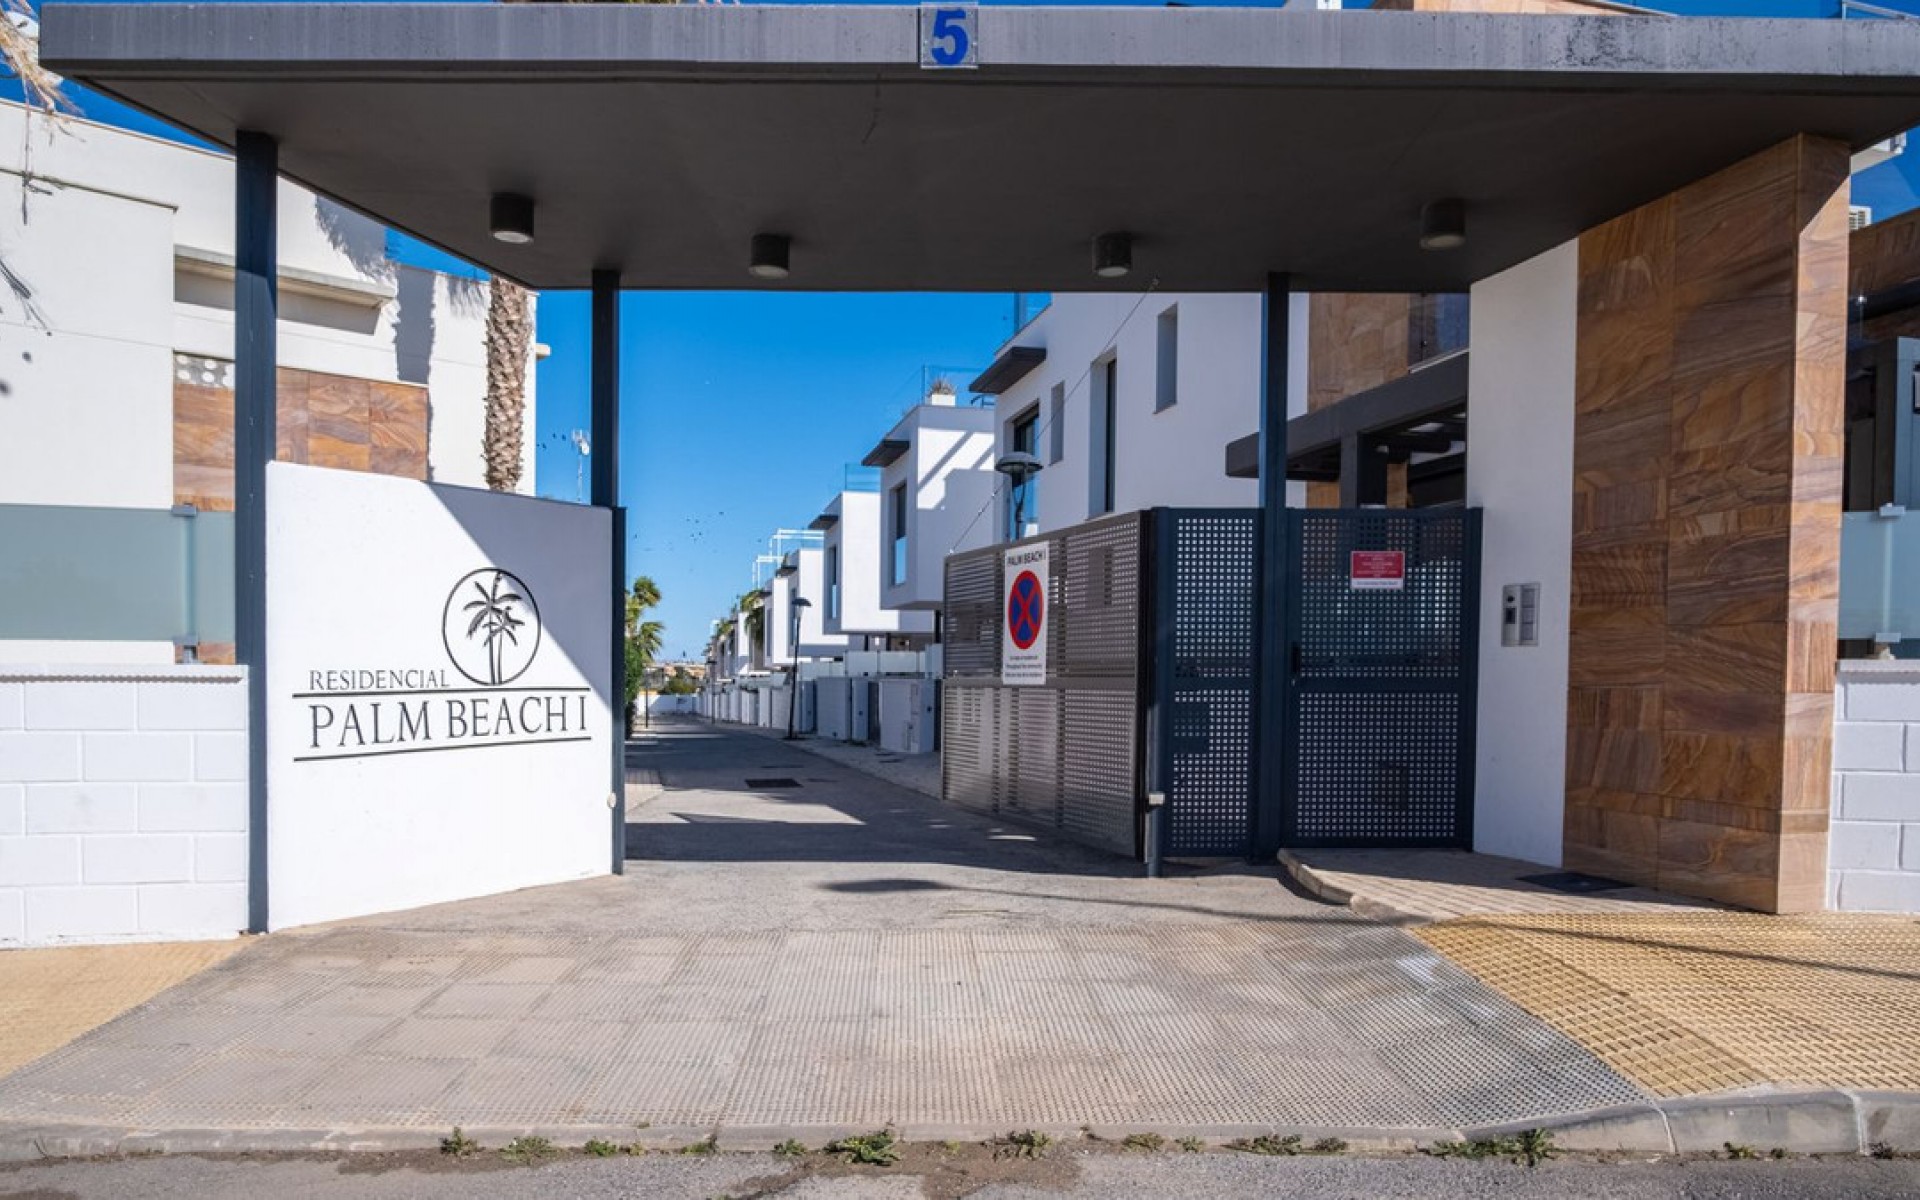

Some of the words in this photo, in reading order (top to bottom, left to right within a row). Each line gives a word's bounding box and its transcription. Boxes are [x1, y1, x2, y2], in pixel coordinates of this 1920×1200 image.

[931, 9, 968, 65] 5
[1024, 551, 1042, 564] BEACH
[309, 669, 450, 691] RESIDENCIAL
[308, 700, 432, 748] PALM
[446, 696, 568, 739] BEACH
[578, 695, 588, 731] I
